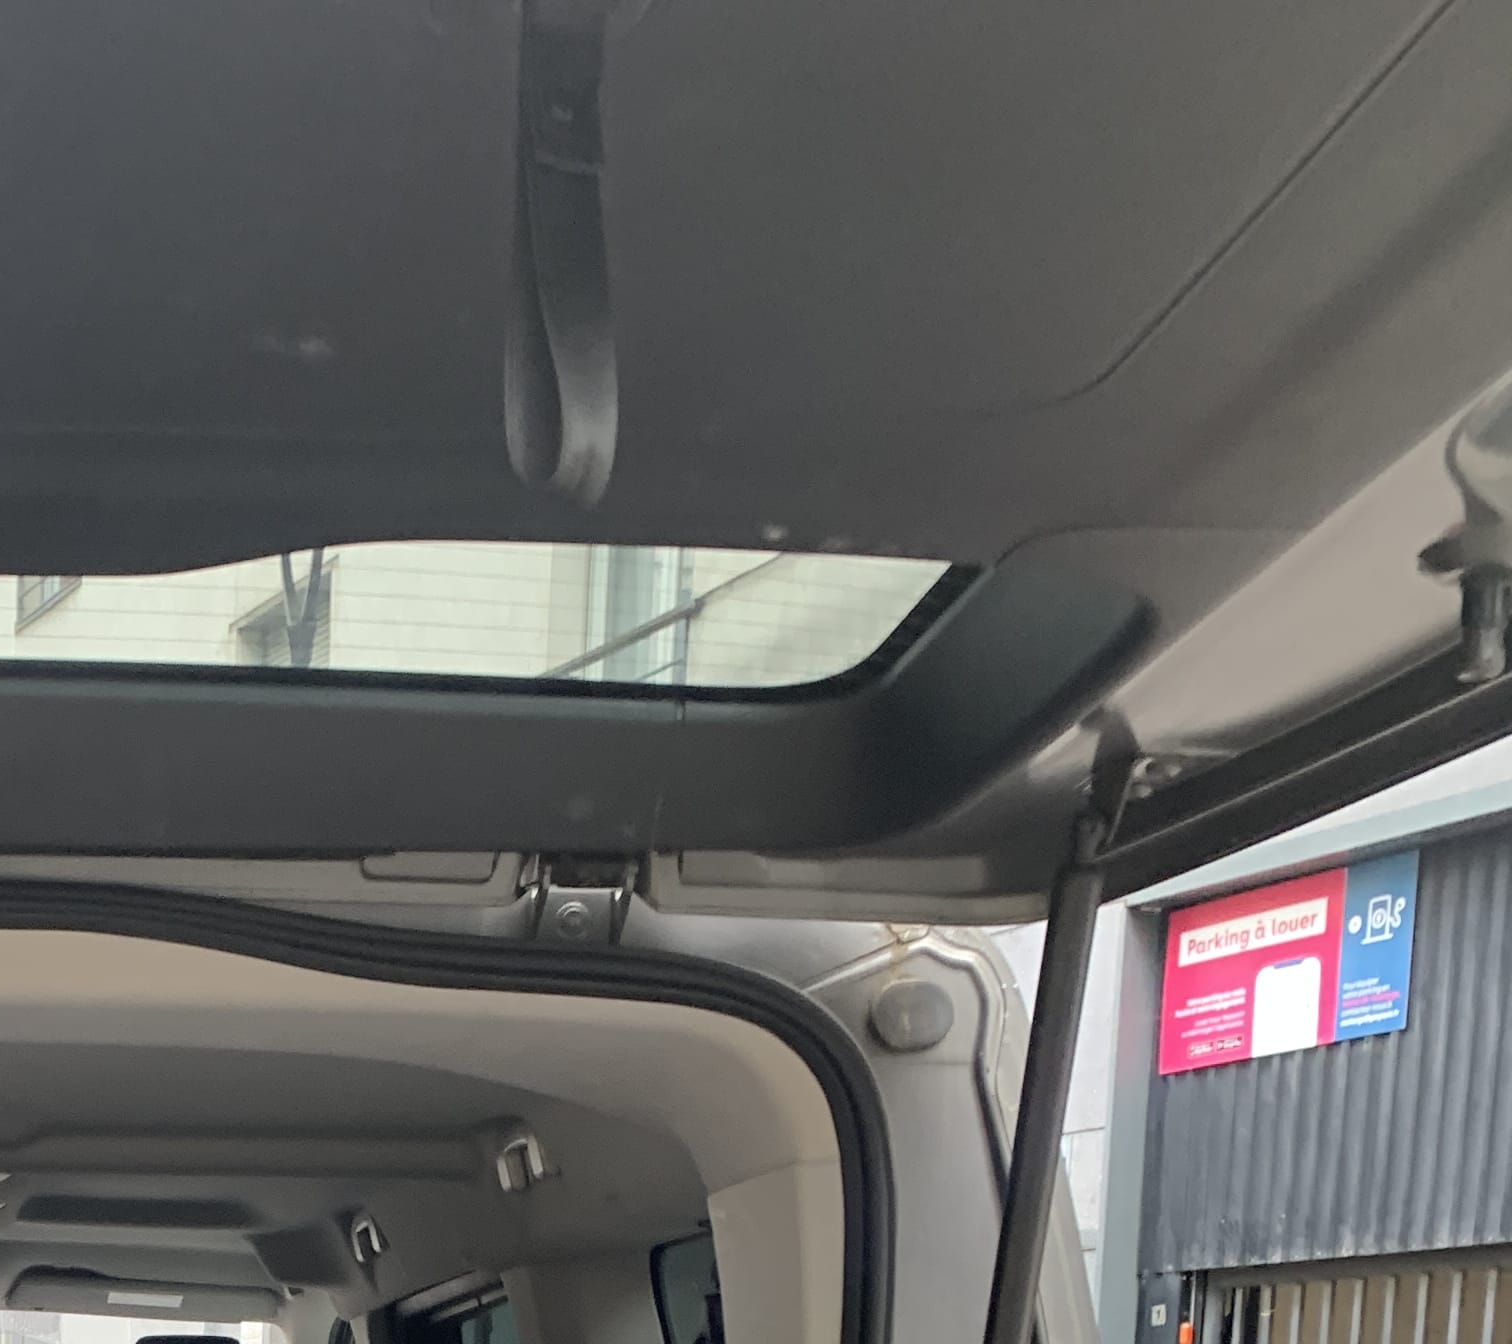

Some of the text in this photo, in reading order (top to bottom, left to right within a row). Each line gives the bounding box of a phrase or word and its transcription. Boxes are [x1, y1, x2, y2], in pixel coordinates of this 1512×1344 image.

[1187, 912, 1319, 957] Parking à louer
